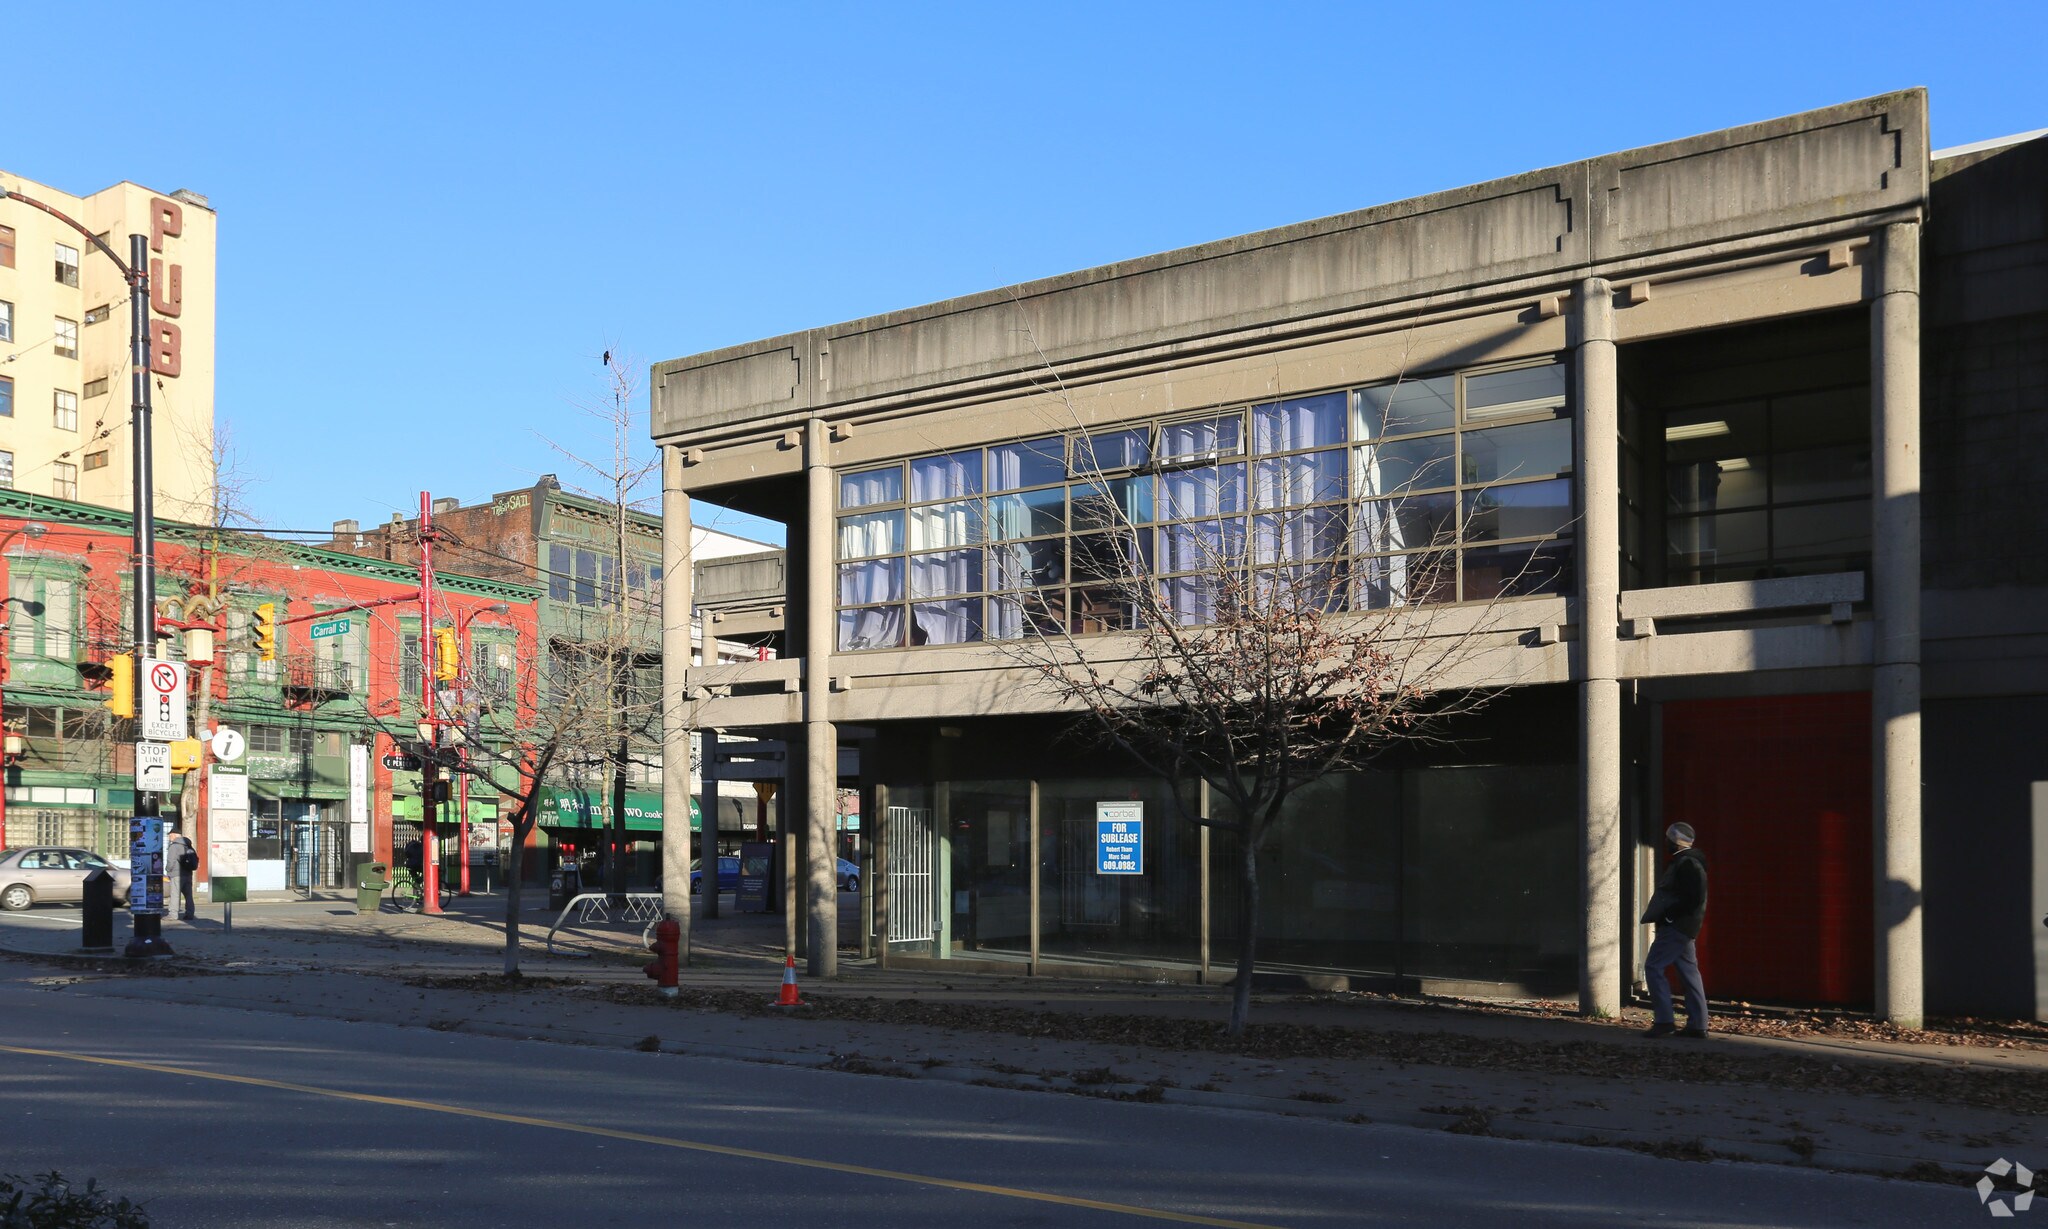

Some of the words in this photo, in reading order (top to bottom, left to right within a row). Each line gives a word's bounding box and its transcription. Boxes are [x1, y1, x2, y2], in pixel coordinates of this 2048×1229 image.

[150, 197, 182, 379] PUB
[313, 623, 337, 637] Carrall
[339, 621, 347, 632] St
[151, 722, 178, 730] EXCEPT
[148, 728, 181, 737] BICYCLES
[140, 746, 167, 756] STOP
[145, 756, 163, 764] LINE
[1109, 809, 1136, 818] corbel
[1112, 823, 1127, 832] FOR
[1101, 833, 1138, 843] SUBLEASE
